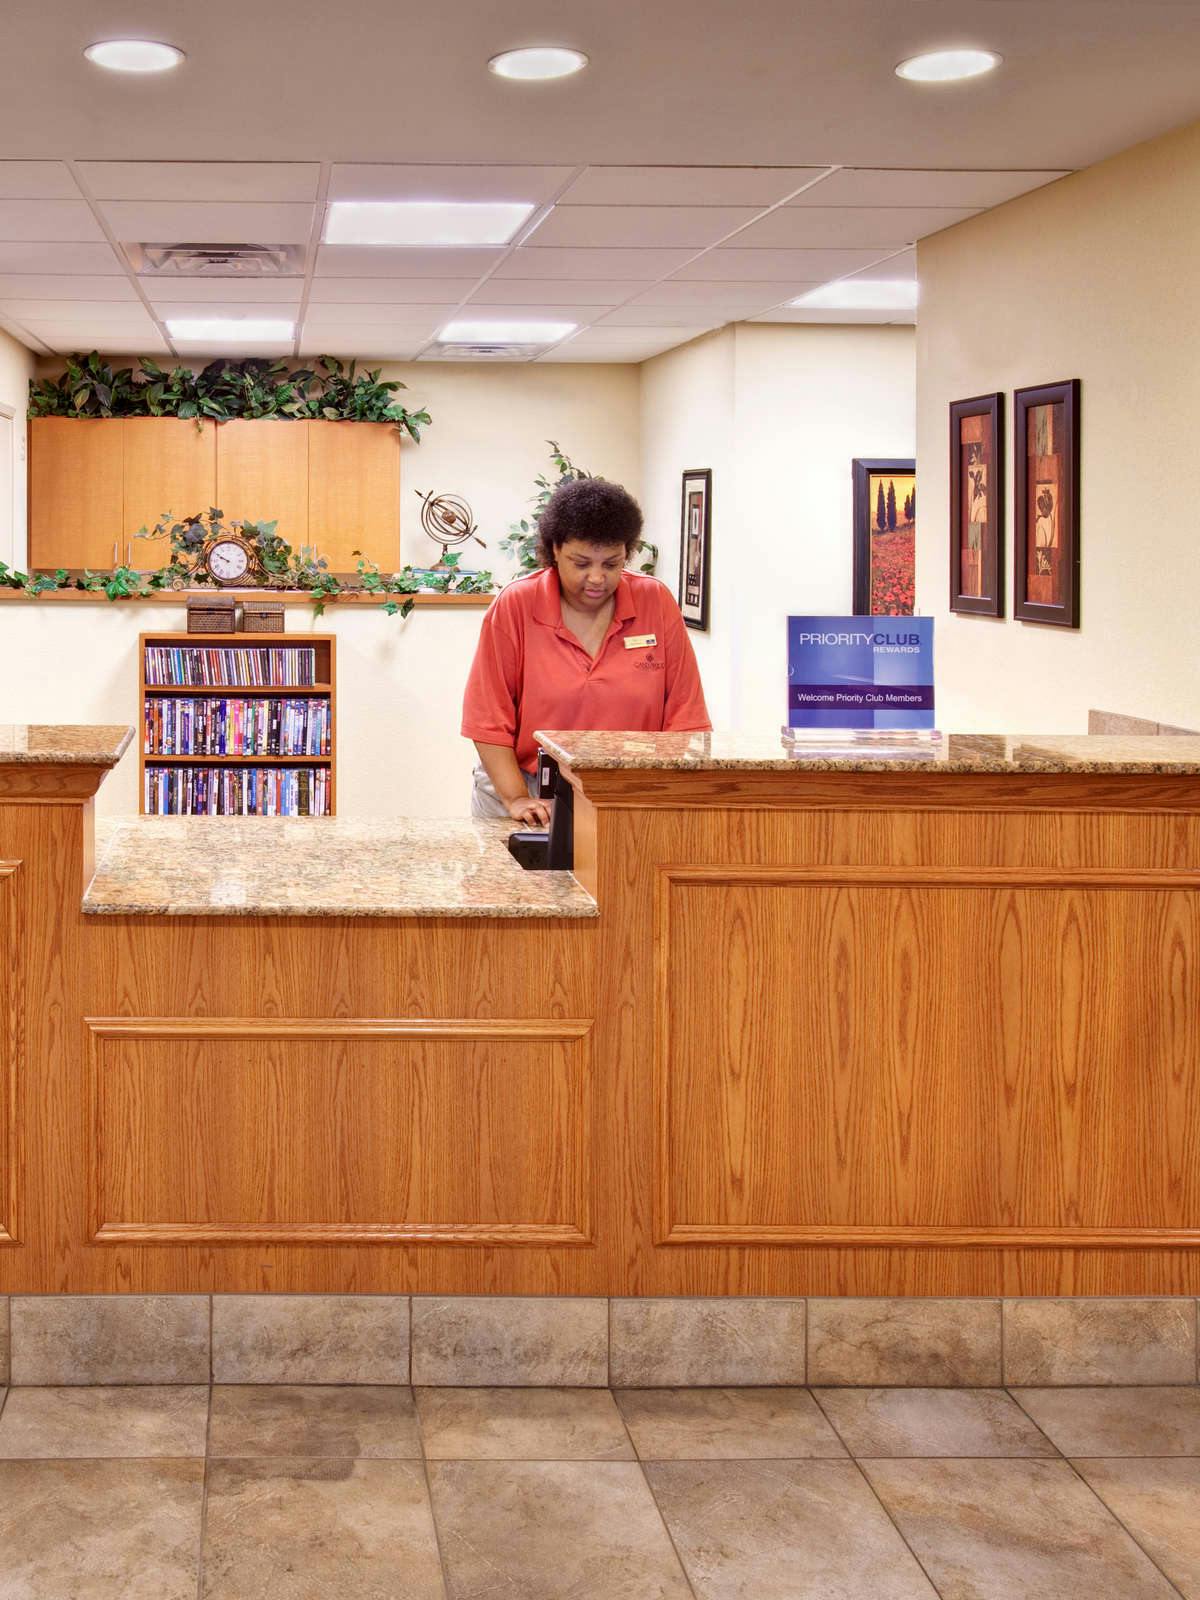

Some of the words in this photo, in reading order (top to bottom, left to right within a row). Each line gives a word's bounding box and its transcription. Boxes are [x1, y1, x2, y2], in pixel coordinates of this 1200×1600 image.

[873, 646, 921, 654] REWARDS
[798, 693, 835, 702] Welcome
[836, 693, 863, 704] Priority
[865, 693, 884, 702] Club
[886, 694, 922, 703] Members
